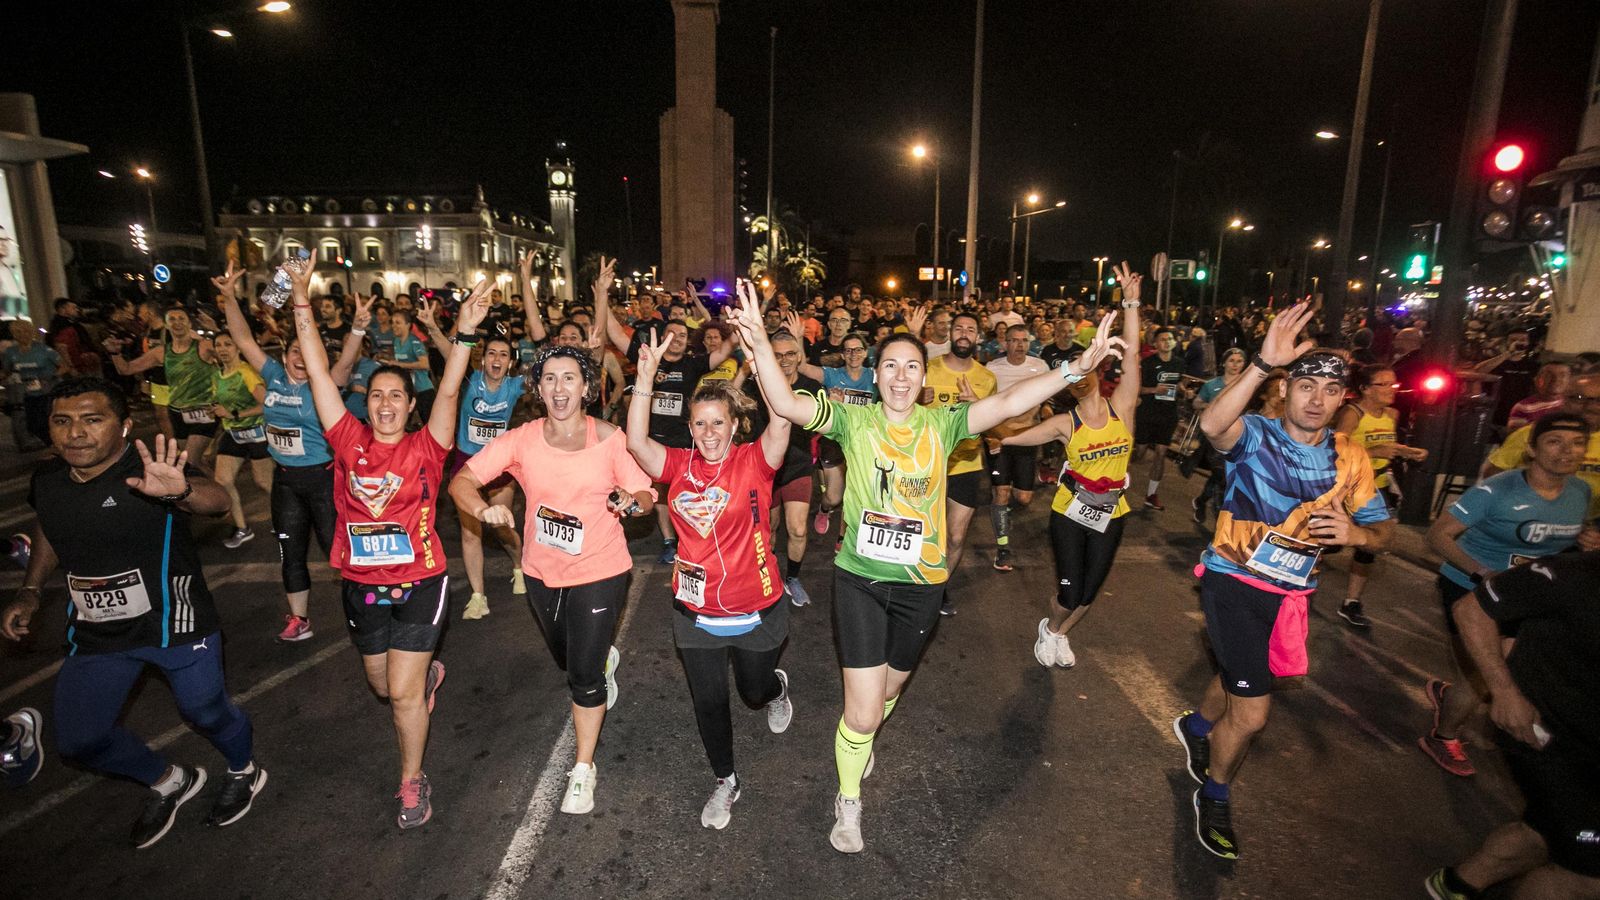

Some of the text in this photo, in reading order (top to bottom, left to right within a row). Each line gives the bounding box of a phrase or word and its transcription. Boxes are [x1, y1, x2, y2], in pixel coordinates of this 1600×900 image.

[273, 433, 293, 447] 9778
[476, 427, 498, 438] 9960
[1079, 444, 1129, 462] runners
[1078, 504, 1104, 521] 9235
[542, 519, 575, 543] 10733
[867, 526, 912, 551] 10755
[362, 534, 399, 552] 6871
[1269, 547, 1307, 571] 6468
[681, 573, 699, 596] 10765
[83, 589, 128, 609] 9229
